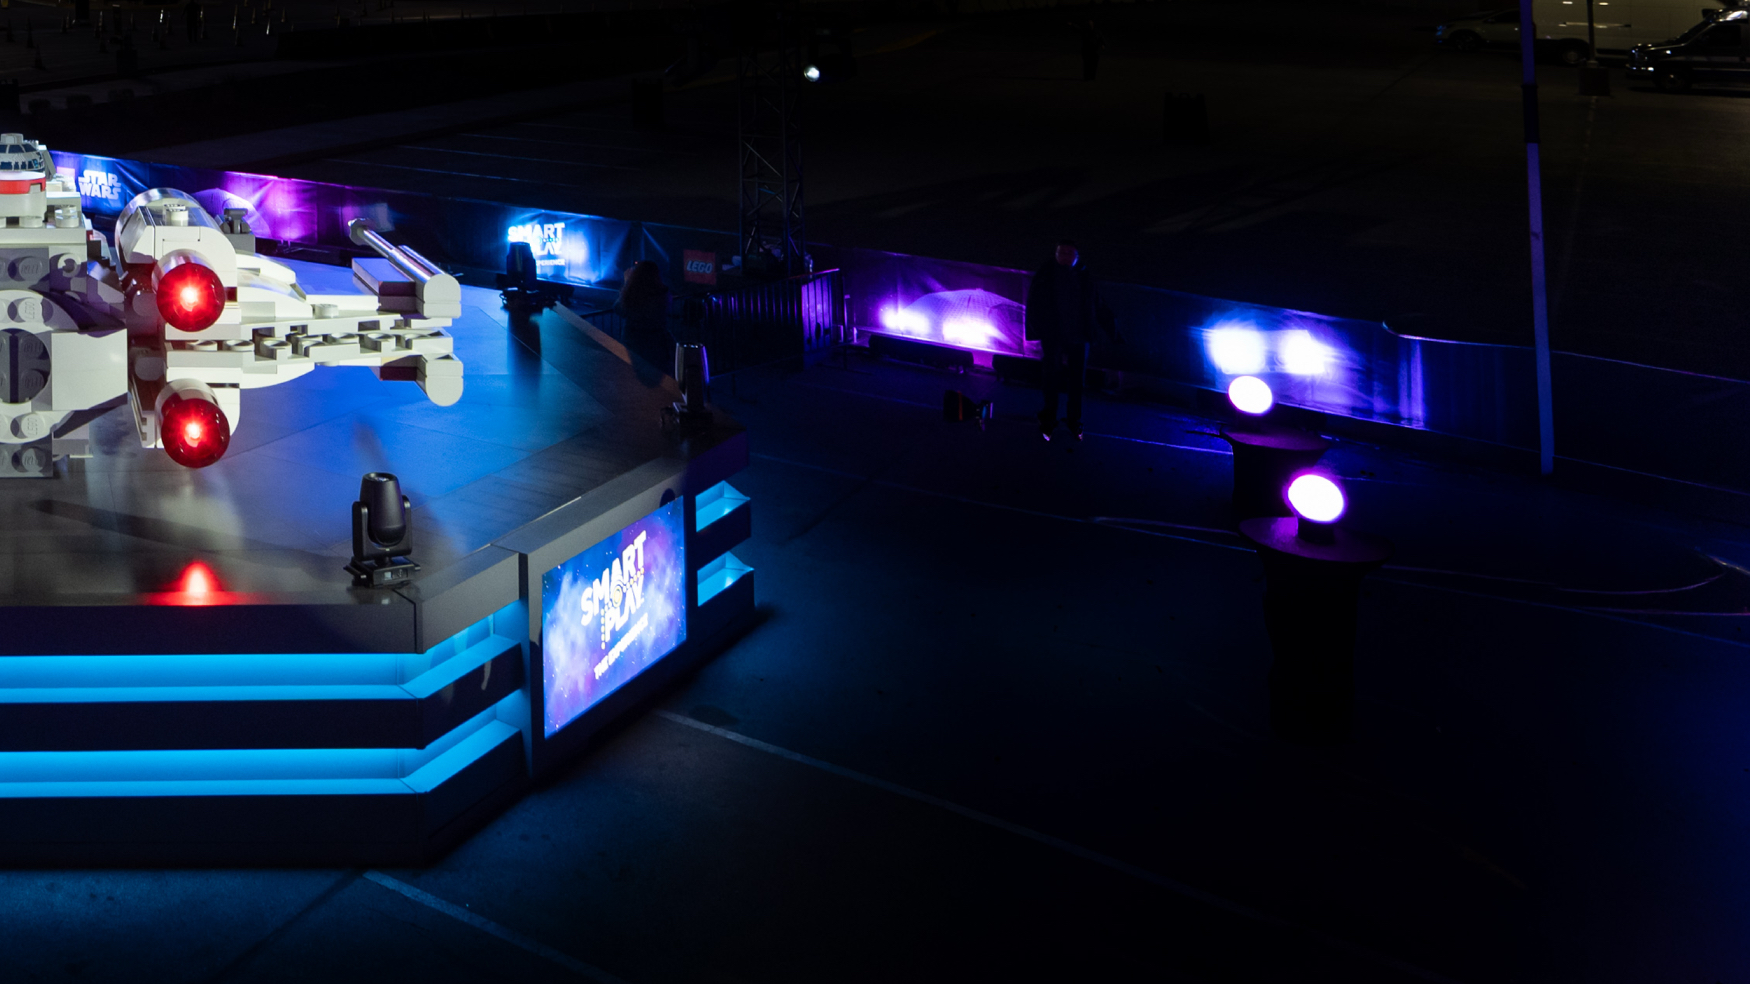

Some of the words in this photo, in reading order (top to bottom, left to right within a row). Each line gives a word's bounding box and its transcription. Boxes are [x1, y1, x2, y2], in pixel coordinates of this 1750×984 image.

[78, 169, 122, 188] STAR
[78, 182, 122, 200] WARS
[508, 222, 565, 243] SMART
[686, 259, 713, 274] LEGO
[580, 530, 647, 626] SMART
[604, 574, 645, 643] PLAY
